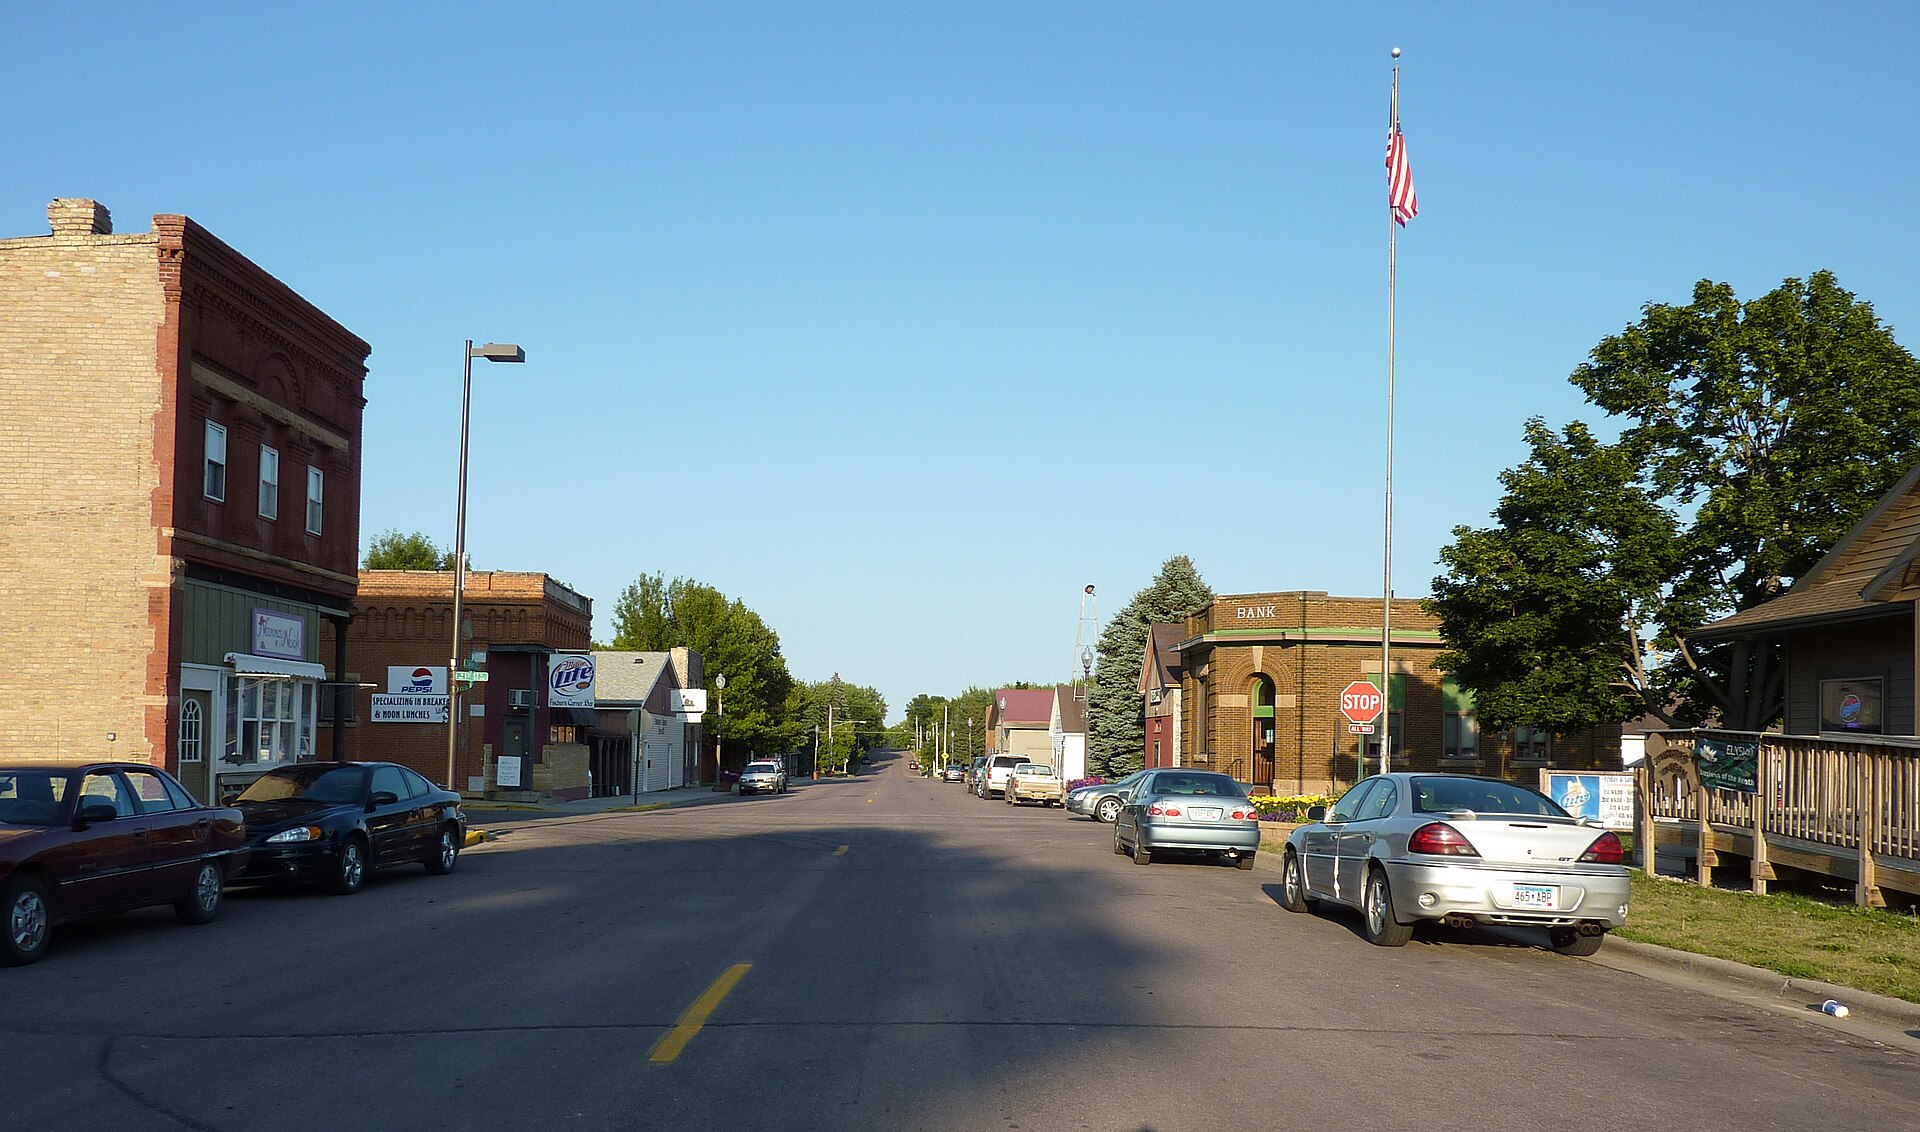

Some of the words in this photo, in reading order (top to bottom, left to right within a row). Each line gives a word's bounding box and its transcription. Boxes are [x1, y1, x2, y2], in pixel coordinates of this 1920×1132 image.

[1237, 606, 1275, 618] BANK
[373, 697, 413, 706] SPECIALIZING
[414, 697, 422, 706] IN
[1343, 694, 1380, 710] STOP
[375, 709, 381, 719] &
[382, 710, 401, 719] NOON
[402, 710, 430, 719] LUNCHES
